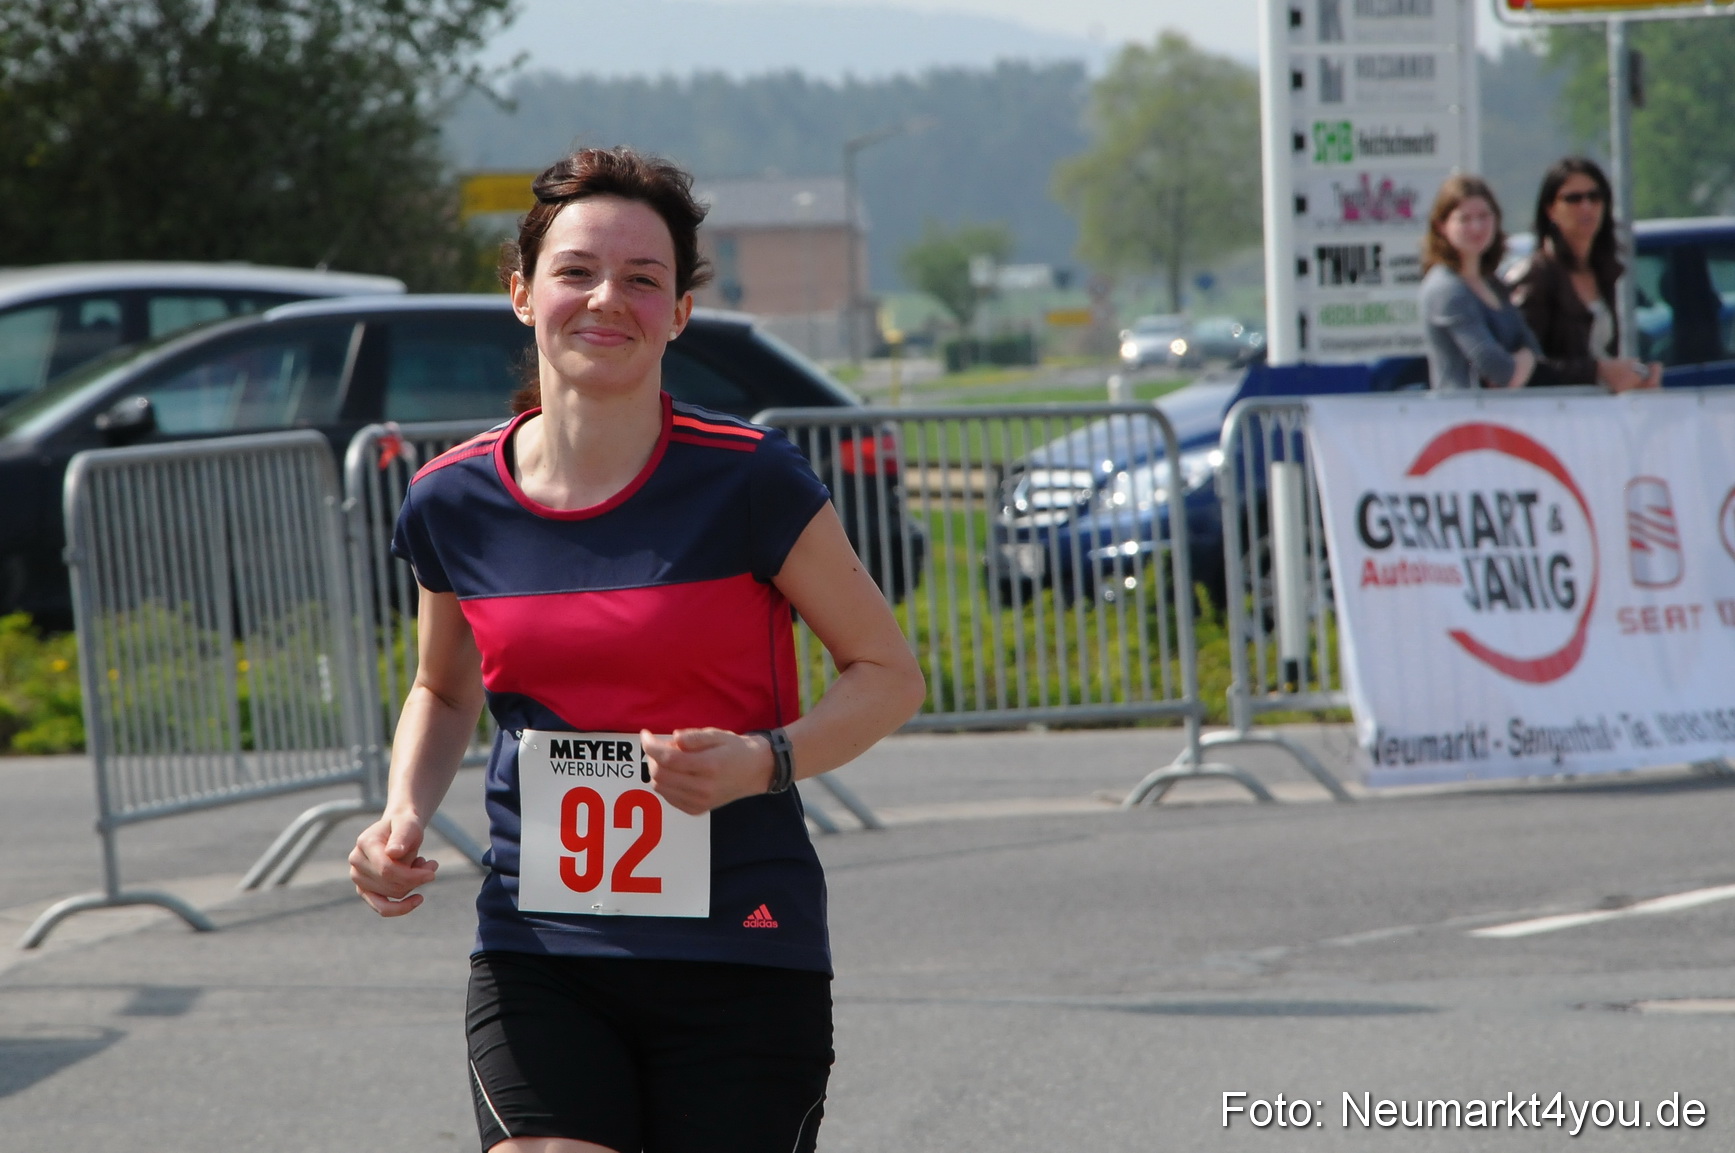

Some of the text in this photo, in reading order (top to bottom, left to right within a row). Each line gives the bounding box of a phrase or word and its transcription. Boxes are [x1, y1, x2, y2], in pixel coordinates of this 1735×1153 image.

[1317, 244, 1382, 286] THULE
[1358, 490, 1564, 550] GERHART &
[1617, 602, 1706, 635] SEAT
[550, 739, 634, 762] MEYER
[551, 761, 635, 779] WERBUNG
[559, 786, 663, 894] 92
[743, 919, 779, 928] adidas
